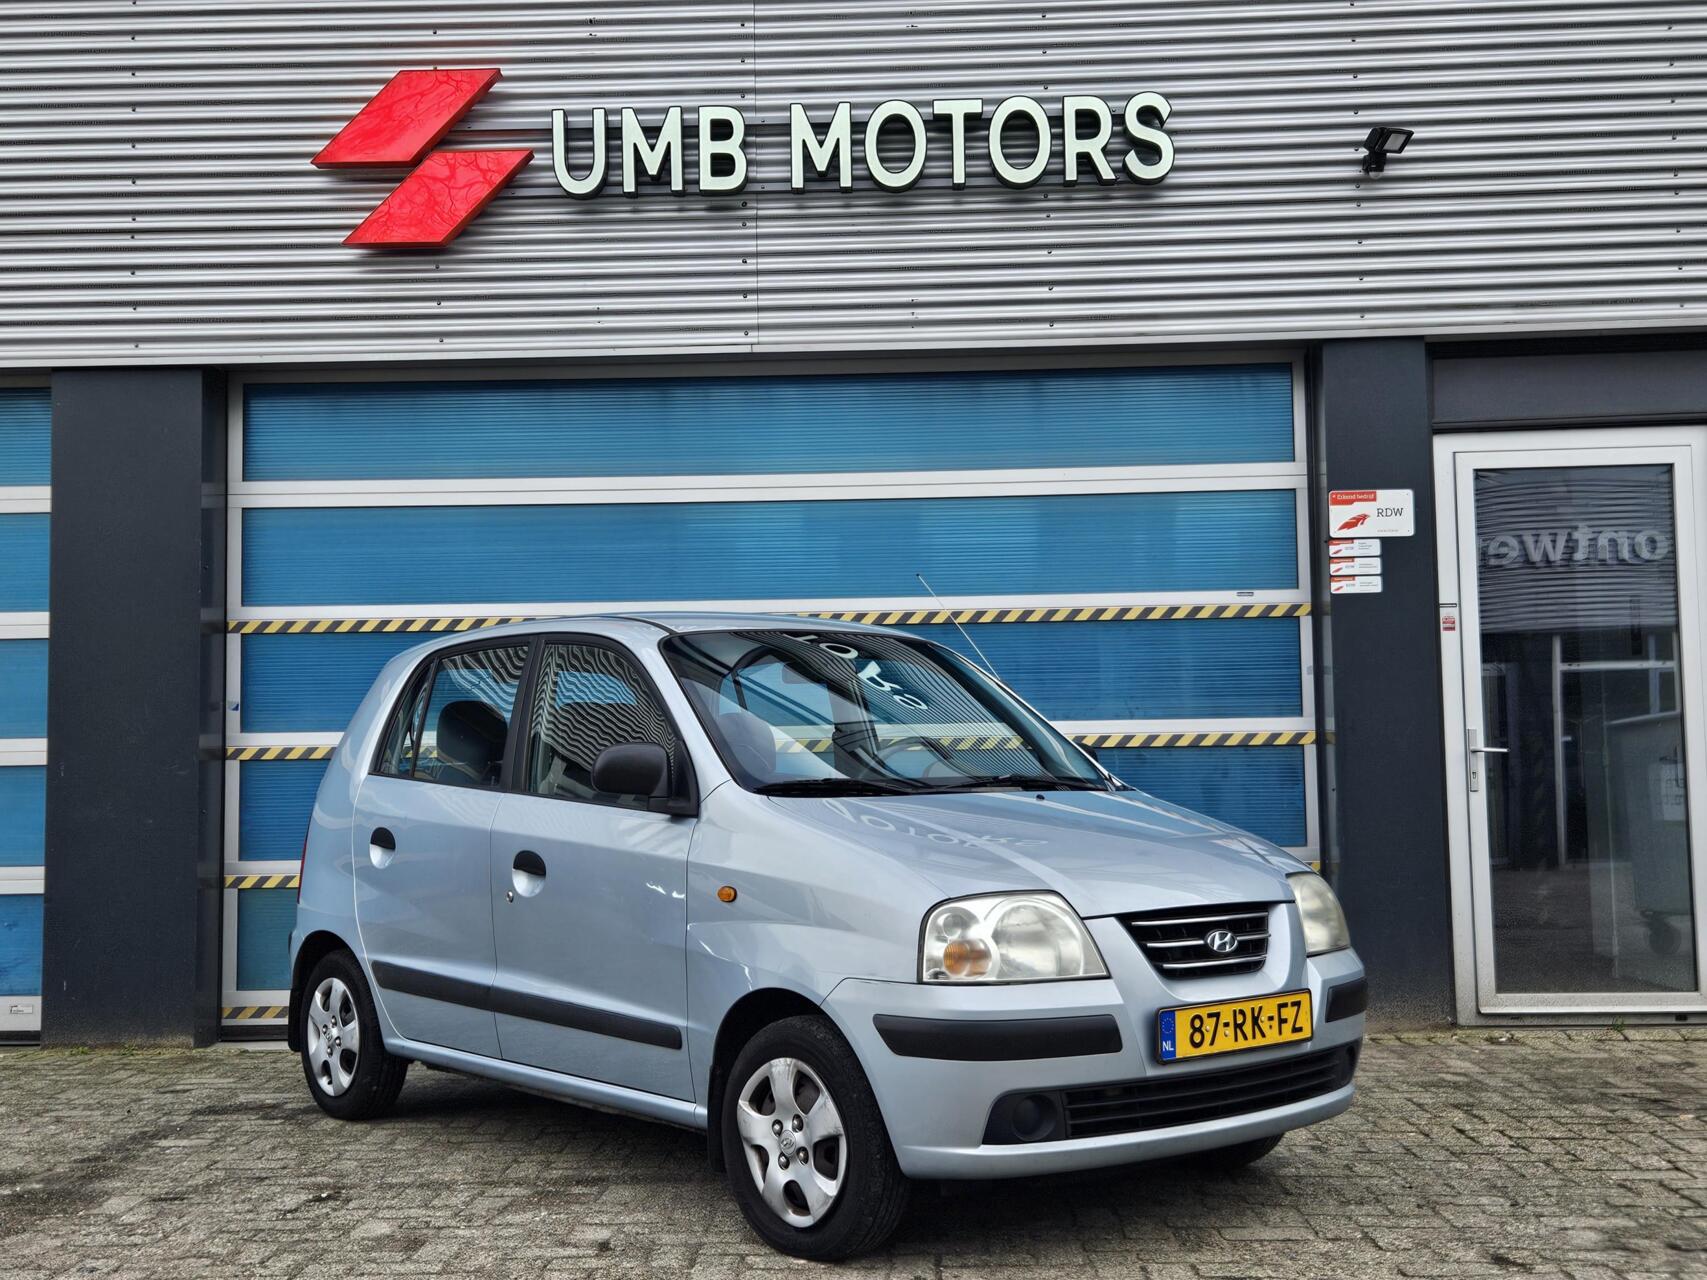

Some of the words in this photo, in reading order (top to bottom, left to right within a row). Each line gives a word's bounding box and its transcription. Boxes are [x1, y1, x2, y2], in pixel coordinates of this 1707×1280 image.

[552, 105, 748, 198] UMB
[790, 91, 1175, 192] MOTORS
[1376, 507, 1404, 518] RDW
[1189, 1000, 1304, 1049] 87-RK-FZ
[1162, 1040, 1175, 1051] NL
